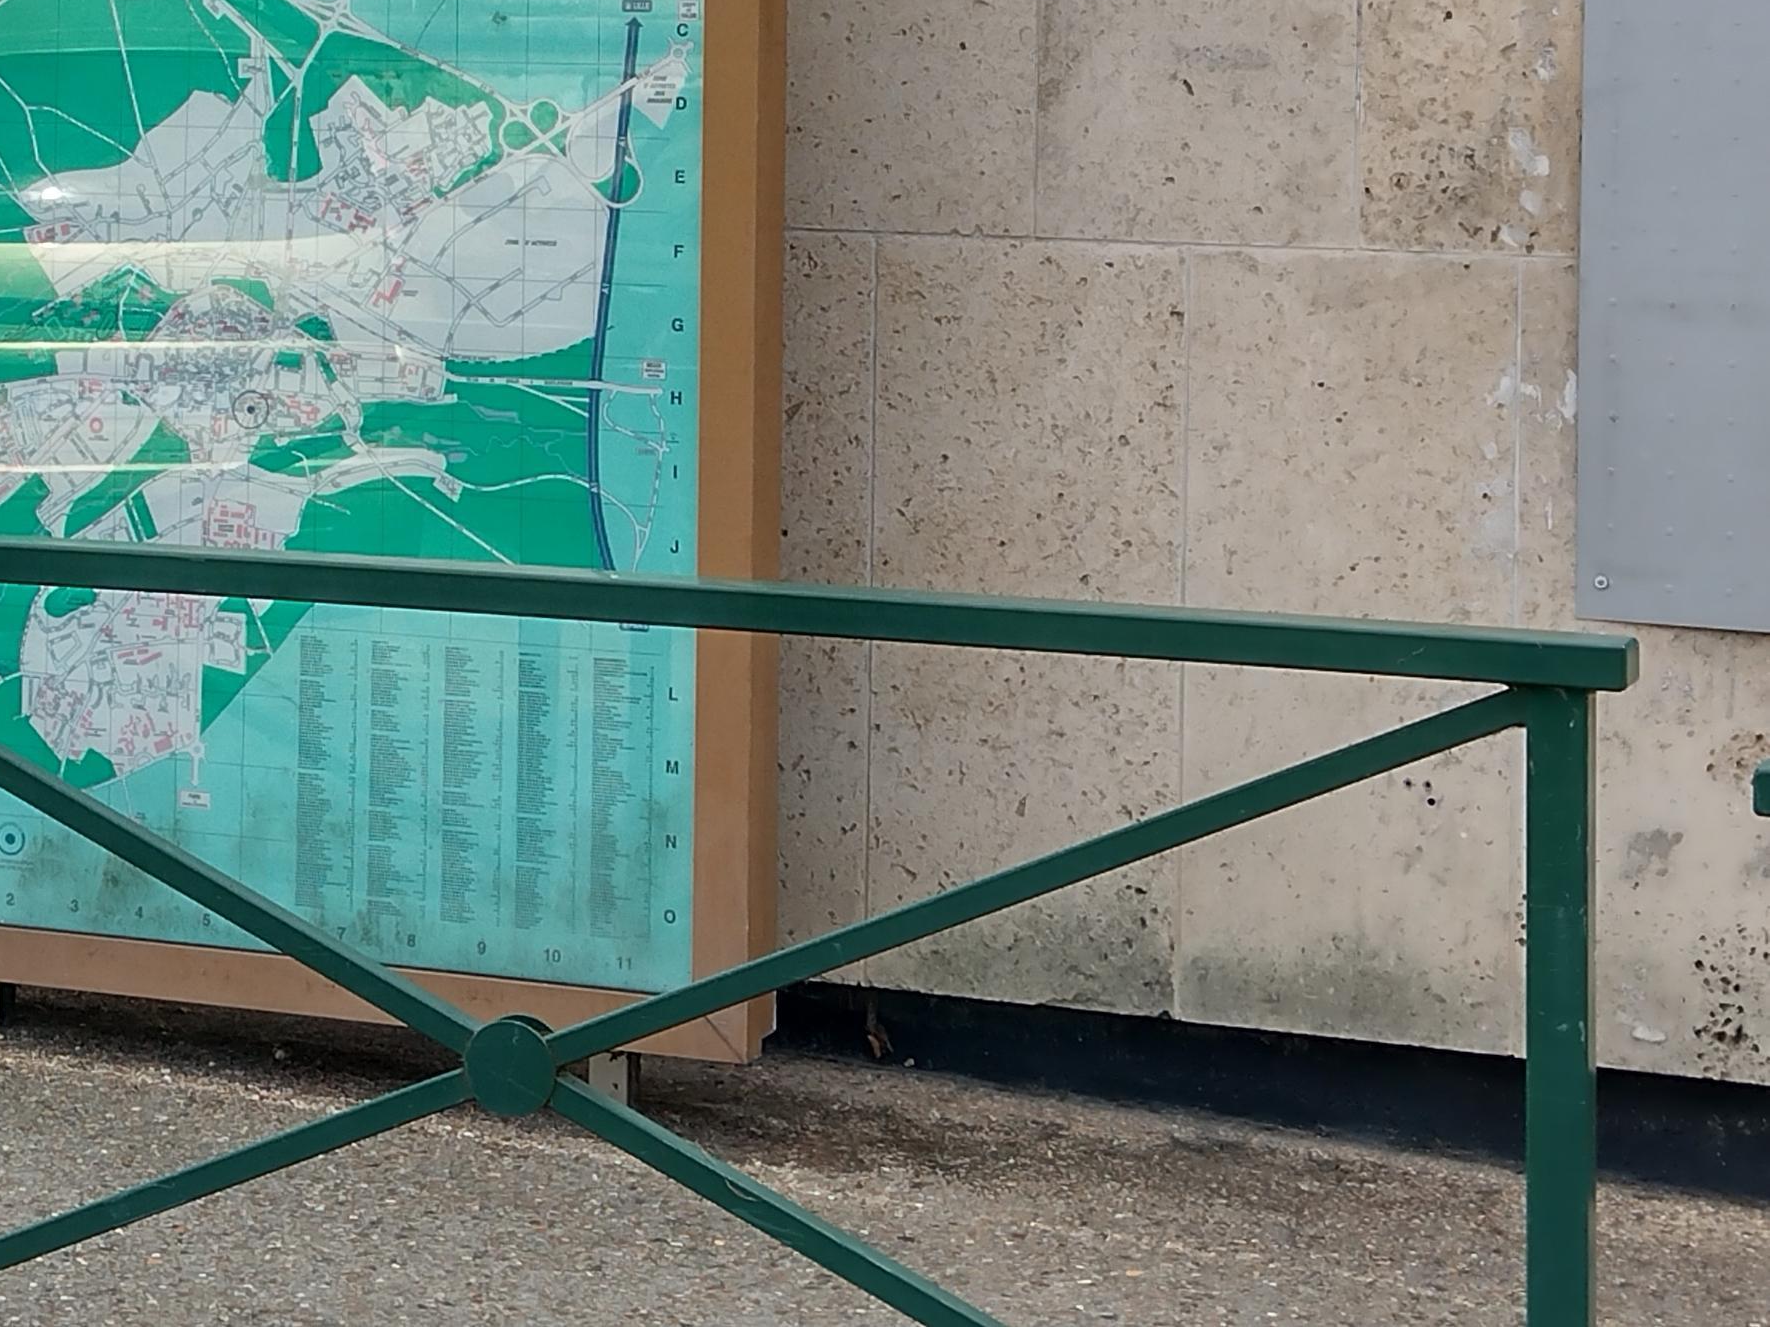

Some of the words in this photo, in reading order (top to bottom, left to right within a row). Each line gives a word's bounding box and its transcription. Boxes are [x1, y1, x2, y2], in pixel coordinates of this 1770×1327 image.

[676, 23, 689, 38] C
[675, 96, 688, 111] D
[674, 169, 686, 184] E
[673, 244, 685, 259] F
[671, 317, 684, 332] G
[670, 390, 682, 406] H
[669, 539, 679, 554] J
[668, 686, 679, 702] L
[665, 759, 679, 775] M
[665, 834, 677, 849] N
[663, 909, 677, 924] O
[5, 892, 15, 907] 2
[69, 898, 80, 913] 3
[135, 906, 144, 919] 4
[202, 912, 213, 927] 5
[336, 926, 347, 942] 7
[406, 933, 416, 948] 8
[476, 940, 487, 956] 9
[543, 948, 562, 963] 10
[617, 956, 632, 970] 11
